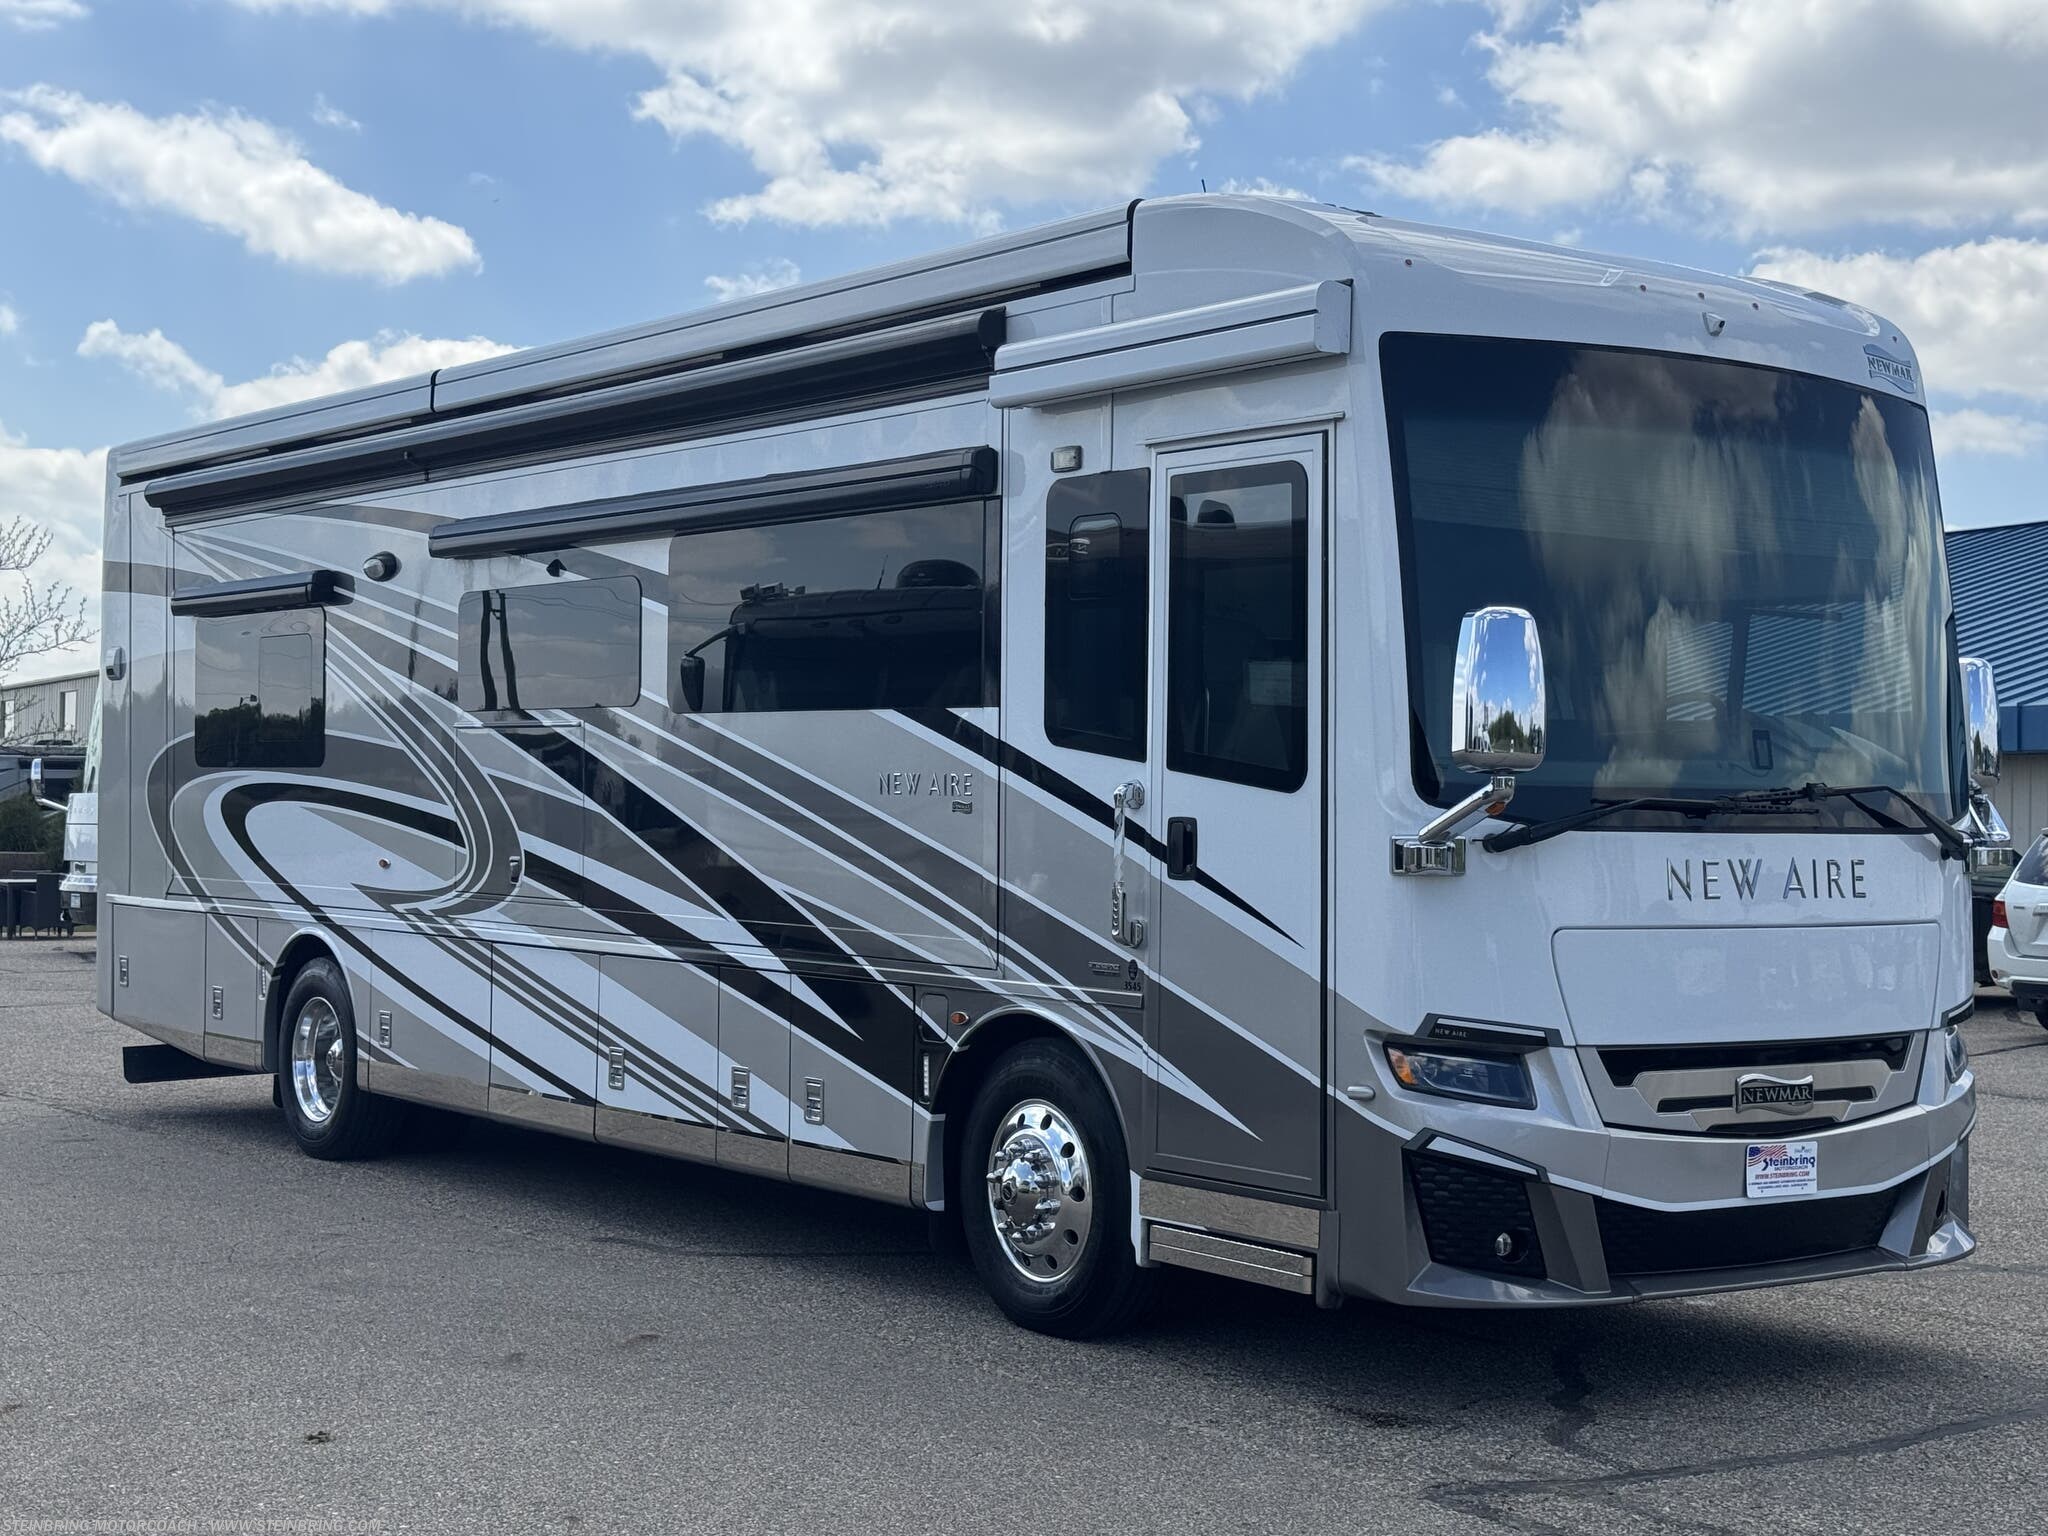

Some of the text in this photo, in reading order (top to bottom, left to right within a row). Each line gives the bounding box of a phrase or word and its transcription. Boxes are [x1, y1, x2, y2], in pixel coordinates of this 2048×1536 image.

[1867, 356, 1913, 381] NEWMAR
[879, 772, 973, 797] NEW AIRE
[1666, 856, 1868, 902] NEW AIRE
[1123, 981, 1142, 992] 3545
[1743, 1086, 1812, 1103] NEWMAR
[1762, 1154, 1815, 1171] Steinbring
